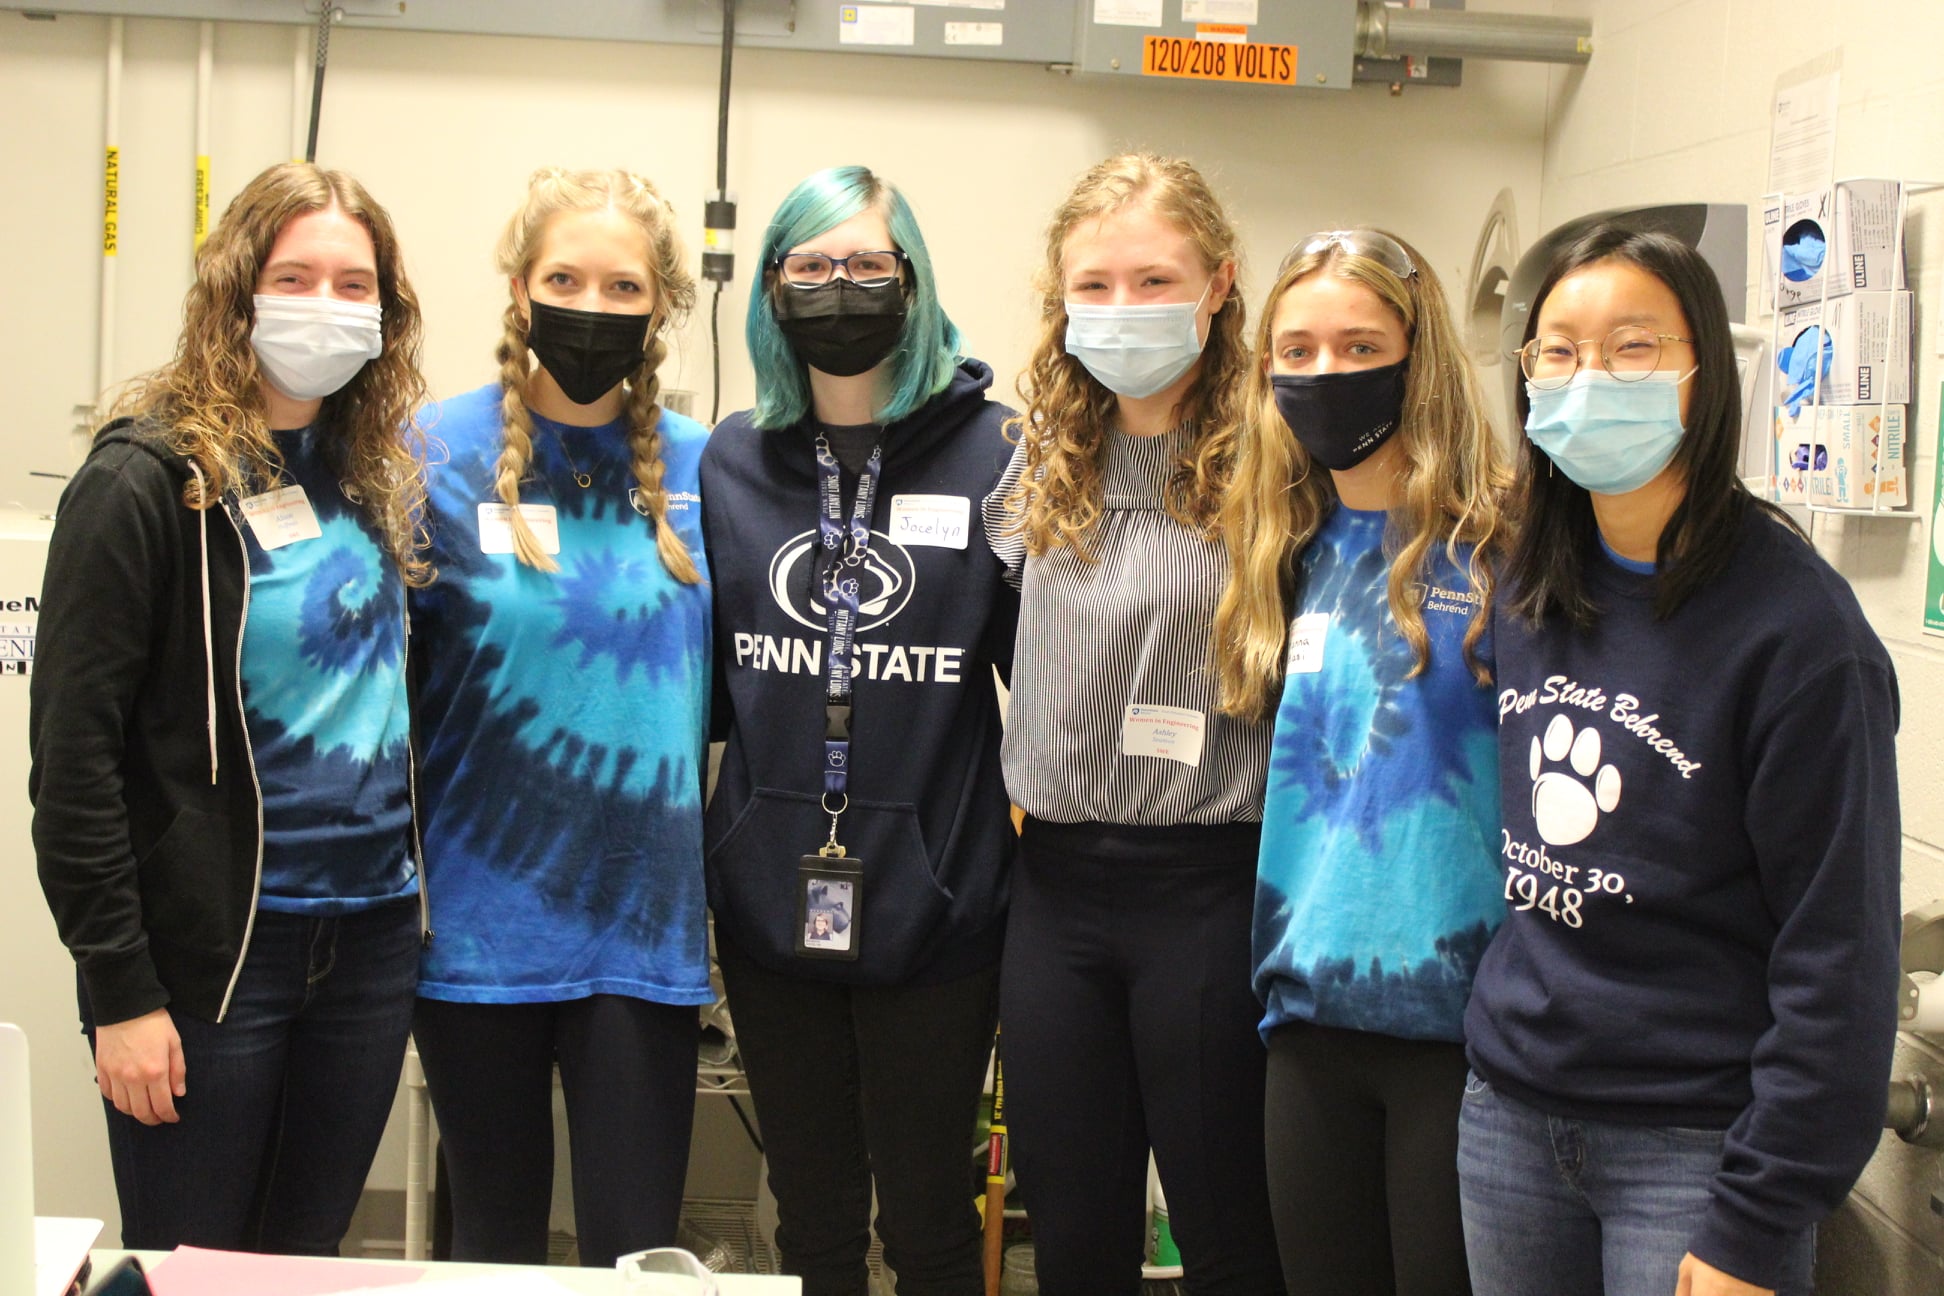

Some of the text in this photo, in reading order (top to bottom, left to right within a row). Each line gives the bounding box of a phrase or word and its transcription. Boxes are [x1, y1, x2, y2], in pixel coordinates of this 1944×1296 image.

[1149, 39, 1292, 81] 120/208 VOLTS
[103, 151, 118, 251] NATURAL GAS
[1854, 254, 1866, 288] ULINE
[1860, 366, 1871, 399] ULINE
[1842, 412, 1851, 449] SMALL
[1887, 415, 1900, 460] NITRILE
[827, 475, 840, 493] LIONS
[853, 500, 867, 519] LIONS
[900, 516, 961, 541] Jocelyn
[1427, 600, 1469, 615] Behrend
[734, 632, 961, 683] PENN STATE
[832, 636, 845, 655] LIONS
[1153, 727, 1177, 738] Ashley
[1162, 718, 1199, 731] Engineering
[1498, 675, 1702, 779] Penn State Behrend
[1504, 866, 1584, 929] 1948
[1584, 868, 1635, 904] 30,
